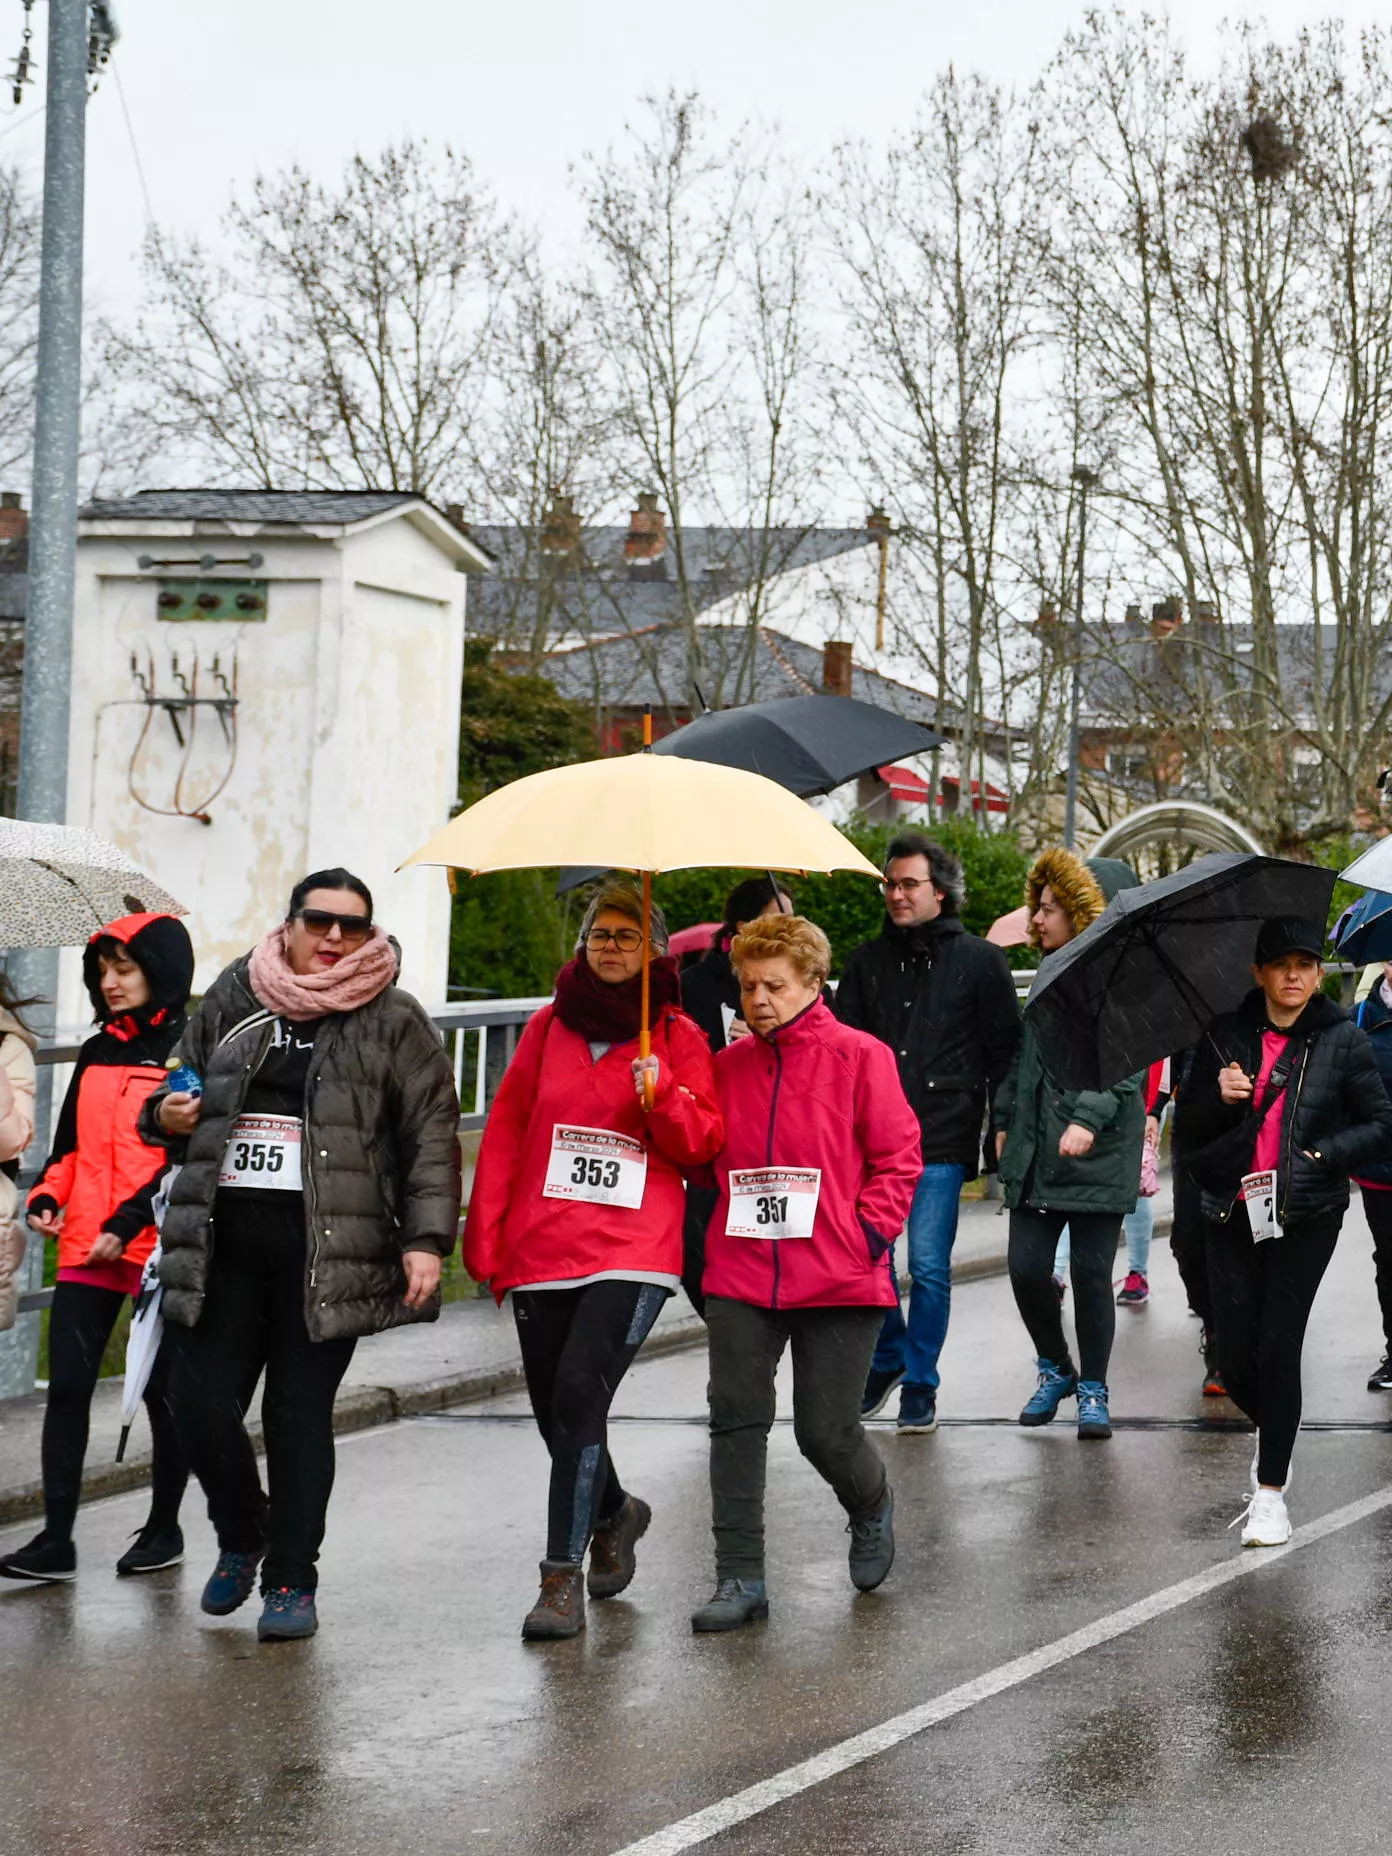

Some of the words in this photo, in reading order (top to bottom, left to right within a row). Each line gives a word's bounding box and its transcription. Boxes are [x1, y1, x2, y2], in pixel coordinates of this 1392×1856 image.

[259, 1119, 271, 1129] de
[562, 1130, 595, 1141] Carrera
[596, 1134, 607, 1144] de
[608, 1136, 617, 1145] la
[617, 1139, 641, 1152] mujer
[234, 1143, 285, 1172] 355
[571, 1156, 621, 1189] 353
[739, 1174, 767, 1184] Carrera
[777, 1172, 786, 1180] la
[786, 1173, 813, 1183] mujer
[756, 1196, 789, 1224] 351
